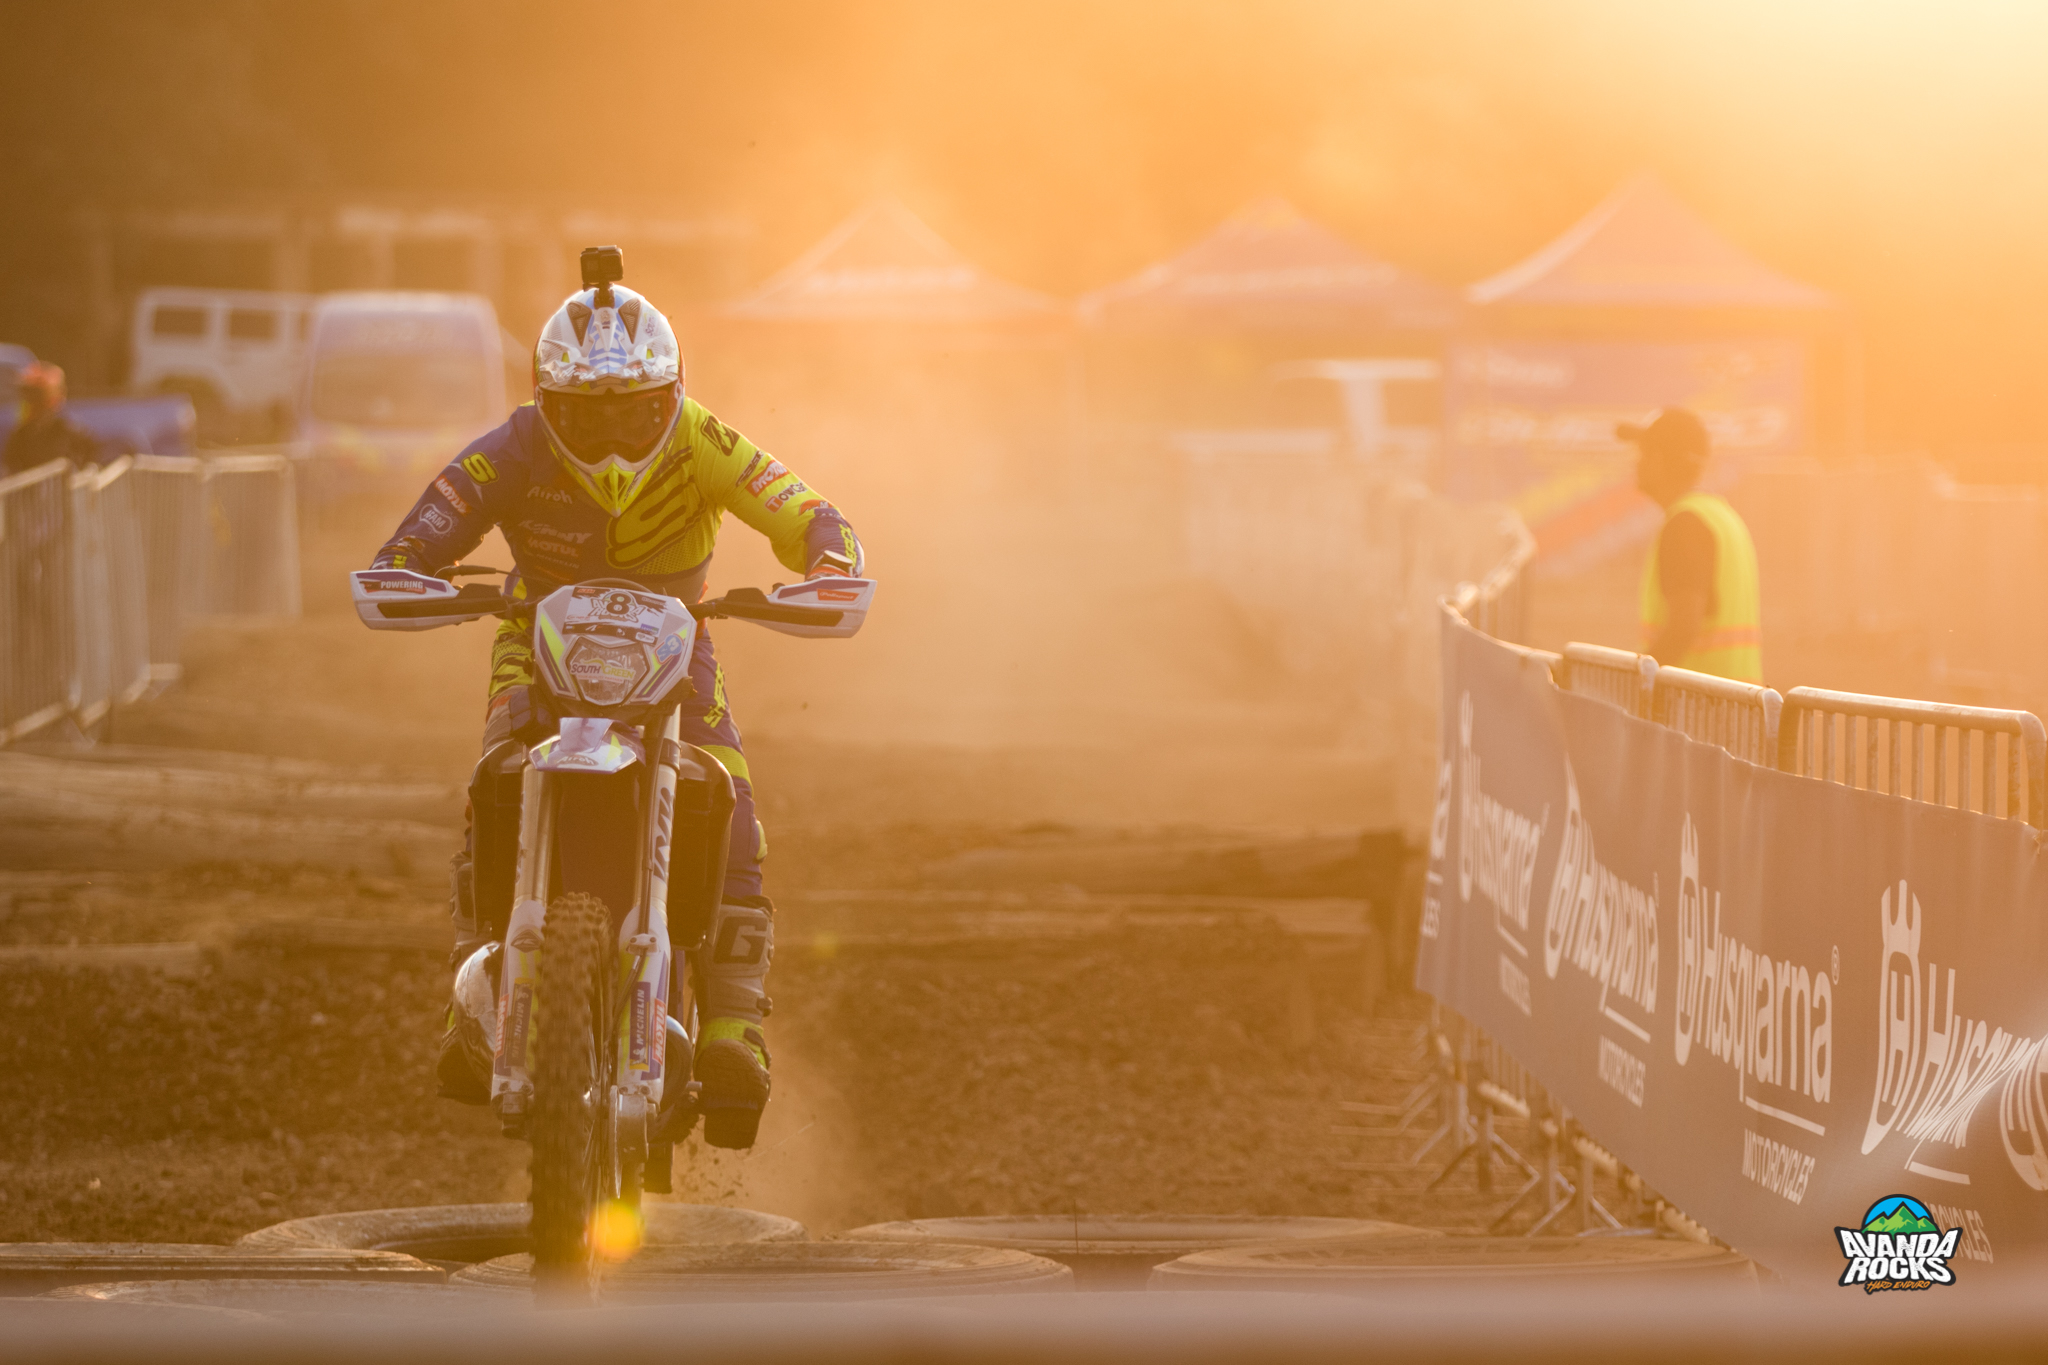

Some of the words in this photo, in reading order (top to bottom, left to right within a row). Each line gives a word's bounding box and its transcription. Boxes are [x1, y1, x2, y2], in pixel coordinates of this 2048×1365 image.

[434, 478, 468, 514] MOTUL
[526, 486, 573, 505] Airoh
[517, 519, 594, 544] KENNY
[527, 537, 579, 558] MOTUL
[380, 581, 424, 590] POWERING
[606, 592, 632, 615] 8
[571, 664, 601, 674] SOUTH
[602, 664, 635, 679] GREEN
[1564, 818, 1659, 1014] Husqvarna
[1696, 886, 1833, 1103] Husqvarna
[511, 1003, 525, 1059] MICHELIN
[635, 989, 645, 1046] MICHELIN
[655, 1003, 666, 1061] MOTUL
[1741, 1128, 1816, 1205] MOTORCYCLES
